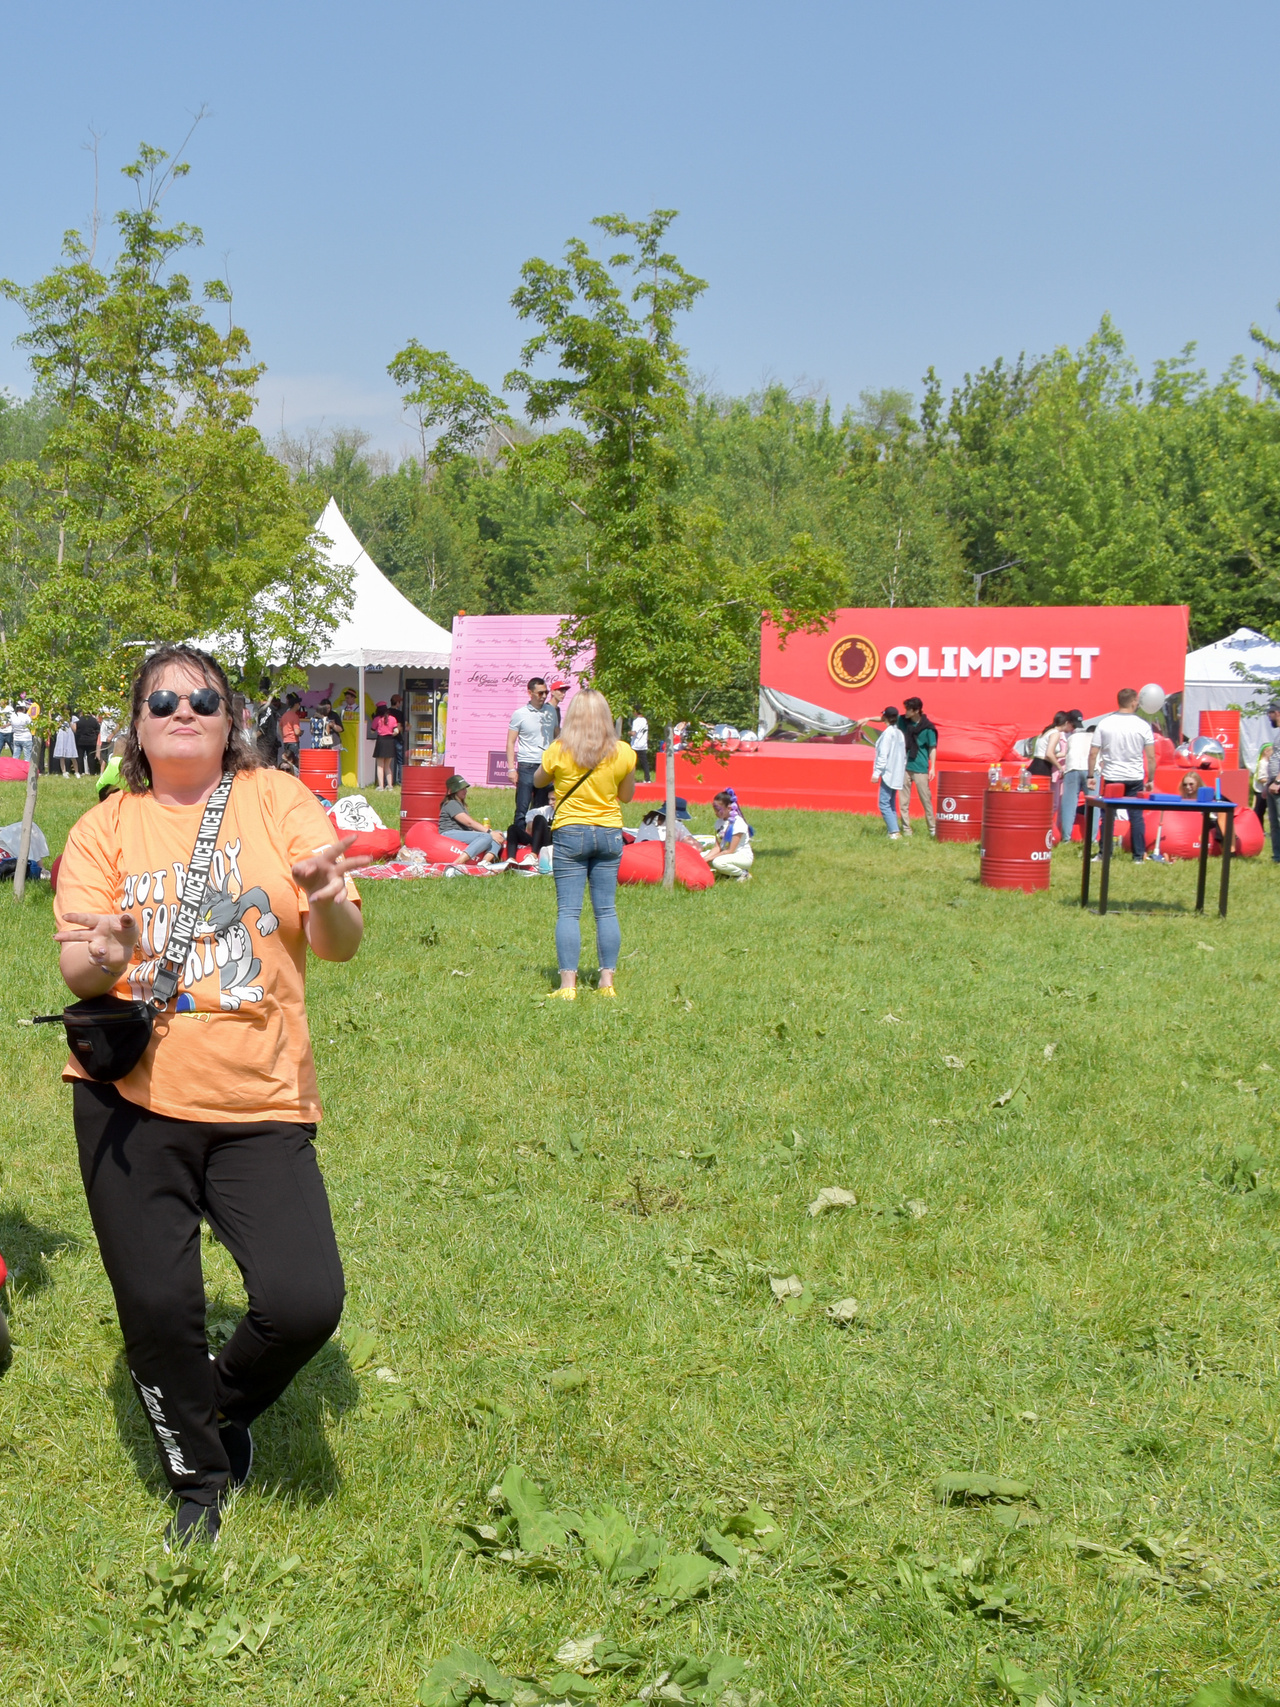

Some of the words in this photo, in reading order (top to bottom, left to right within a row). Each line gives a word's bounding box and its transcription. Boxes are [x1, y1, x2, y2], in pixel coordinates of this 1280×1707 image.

[885, 646, 1100, 679] OLIMPBET
[206, 784, 231, 809] NICE
[198, 810, 223, 840] NICE
[190, 840, 215, 872] NICE
[121, 869, 167, 911] NOT
[183, 871, 207, 908] NICE
[172, 904, 198, 944] NICE
